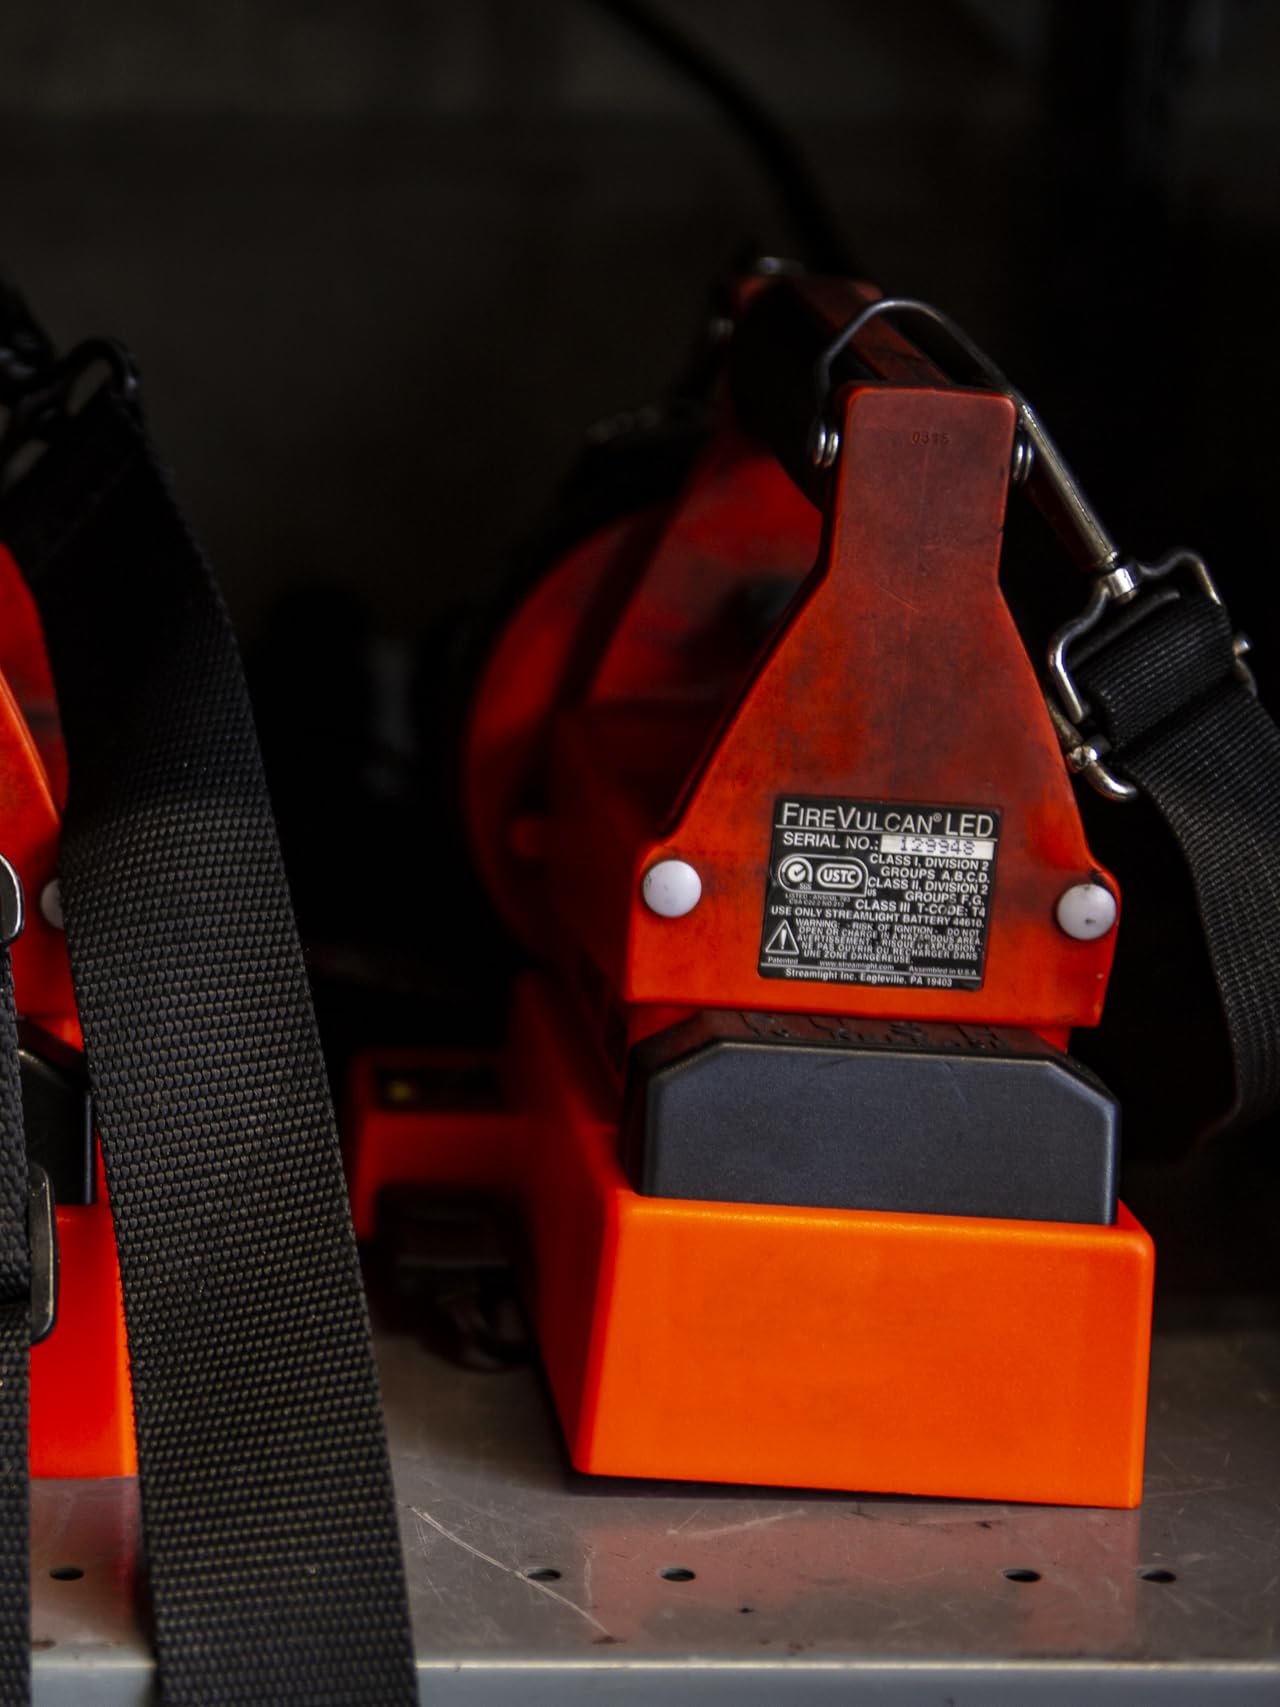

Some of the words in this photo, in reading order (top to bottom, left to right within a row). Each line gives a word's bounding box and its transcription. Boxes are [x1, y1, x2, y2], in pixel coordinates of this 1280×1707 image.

[945, 813, 994, 837] LED
[783, 832, 840, 848] SERIAL
[870, 853, 911, 866] CLASS
[925, 857, 979, 871] DIVISION
[981, 861, 990, 871] 2
[823, 869, 857, 883] USTC
[881, 866, 936, 880] GROUPS
[868, 877, 908, 890] CLASS
[925, 881, 979, 894] DIVISION
[980, 884, 989, 895] 2
[905, 891, 957, 903] GROUPS
[771, 905, 792, 916] USE
[795, 907, 822, 917] ONLY
[825, 909, 900, 922] STREAMLIGHT
[902, 914, 950, 926] BATTERY
[855, 899, 897, 912] CLASS
[900, 902, 910, 913] III
[971, 907, 986, 917] T4
[799, 927, 823, 935] OPEN
[826, 928, 839, 936] OR
[842, 929, 878, 939] CHARGE
[852, 922, 874, 931] RISK
[878, 924, 890, 932] OF
[894, 925, 933, 934] IGNITION
[947, 928, 960, 936] DO
[962, 929, 980, 937] NOT
[817, 943, 834, 951] PAS
[953, 951, 978, 960] DANS
[824, 952, 848, 960] ZONE
[786, 968, 838, 981] Streamlight
[910, 976, 923, 984] PA
[927, 977, 953, 987] 19403
